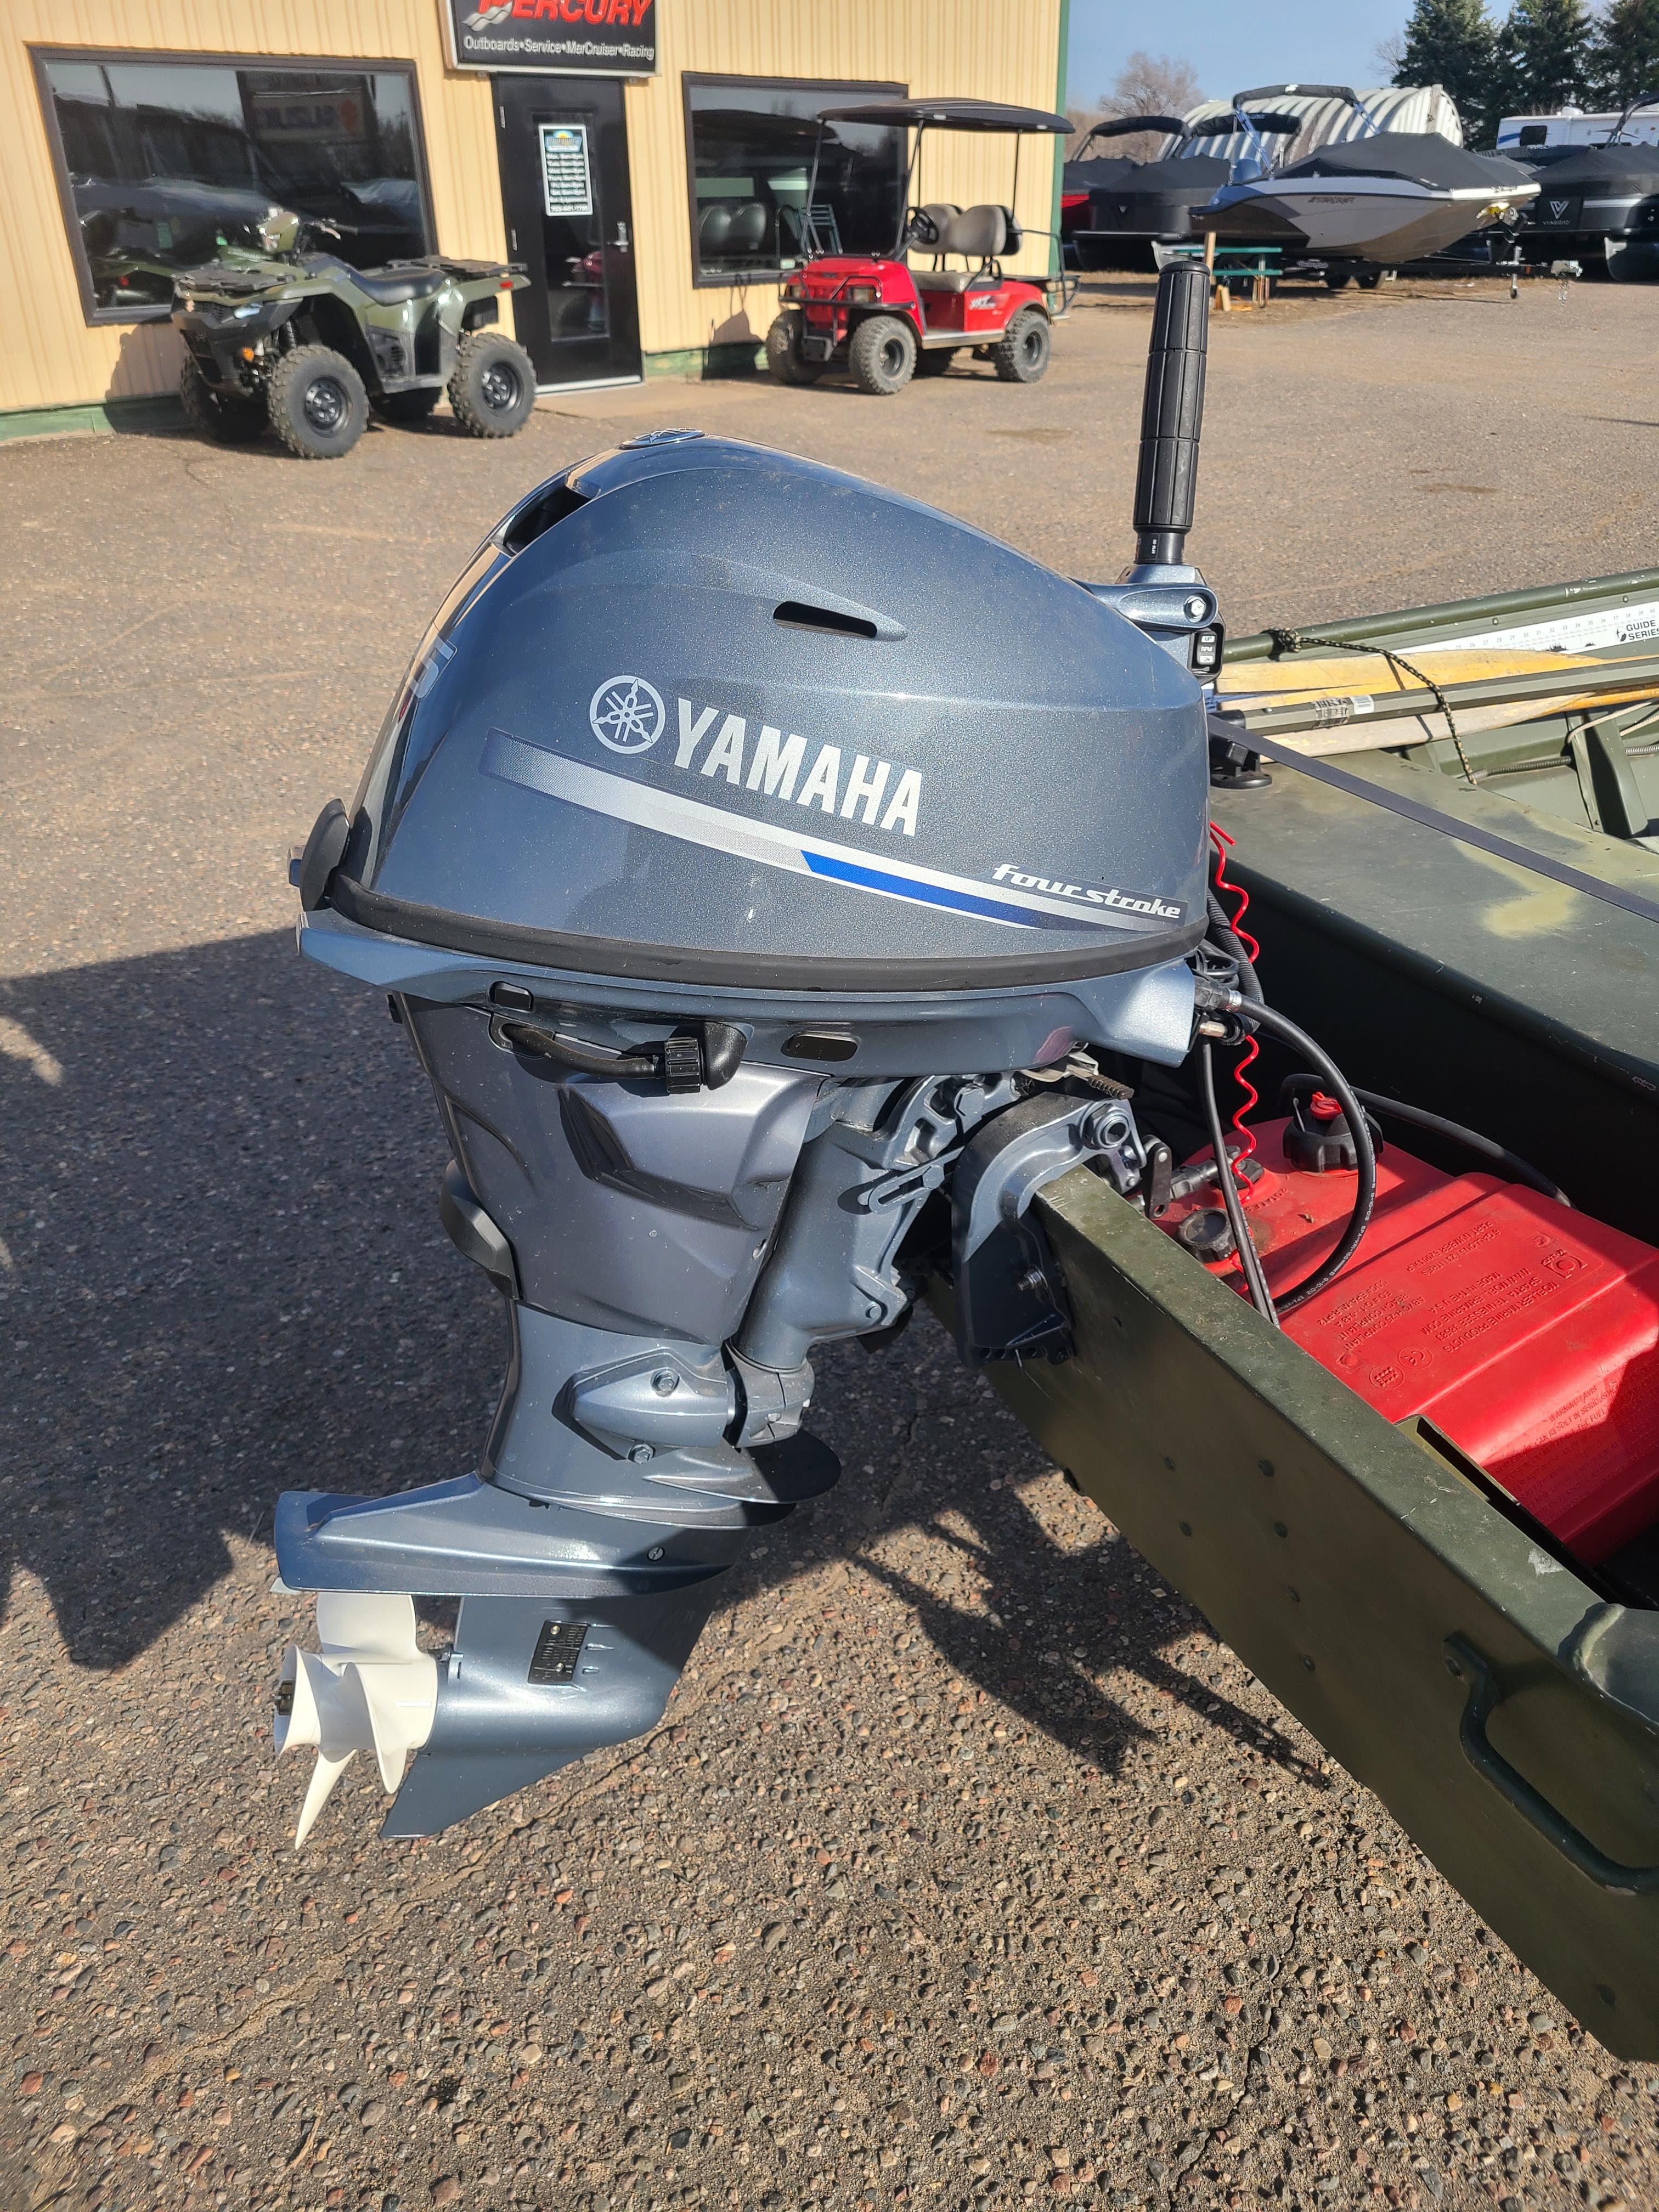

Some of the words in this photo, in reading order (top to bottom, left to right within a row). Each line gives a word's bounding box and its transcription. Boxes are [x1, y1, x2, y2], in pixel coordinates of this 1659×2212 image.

[464, 35, 519, 51] Outboards
[524, 38, 561, 53] Service
[566, 41, 618, 55] MerCruiser
[622, 43, 654, 60] Racing
[1626, 619, 1656, 631] GUIDE
[1628, 628, 1659, 640] SERIES
[674, 697, 923, 837] YAMAHA
[1470, 1220, 1493, 1235] PART
[1438, 1231, 1474, 1254] NUMBER
[1458, 1232, 1494, 1255] GALLONS
[1420, 1259, 1448, 1277] LITRES
[1475, 1270, 1502, 1288] MADE
[1449, 1289, 1470, 1302] THE
[1465, 1284, 1478, 1293] IN
[1517, 1280, 1560, 1307] MOELLER
[1380, 1292, 1409, 1312] REACH
[1458, 1296, 1508, 1327] TENNESSEE
[1337, 1308, 1383, 1341] COMPLIANT
[1486, 1303, 1522, 1325] MARINE
[1341, 1319, 1387, 1352] COMPLIANT
[1442, 1322, 1489, 1353] PRODUCTS
